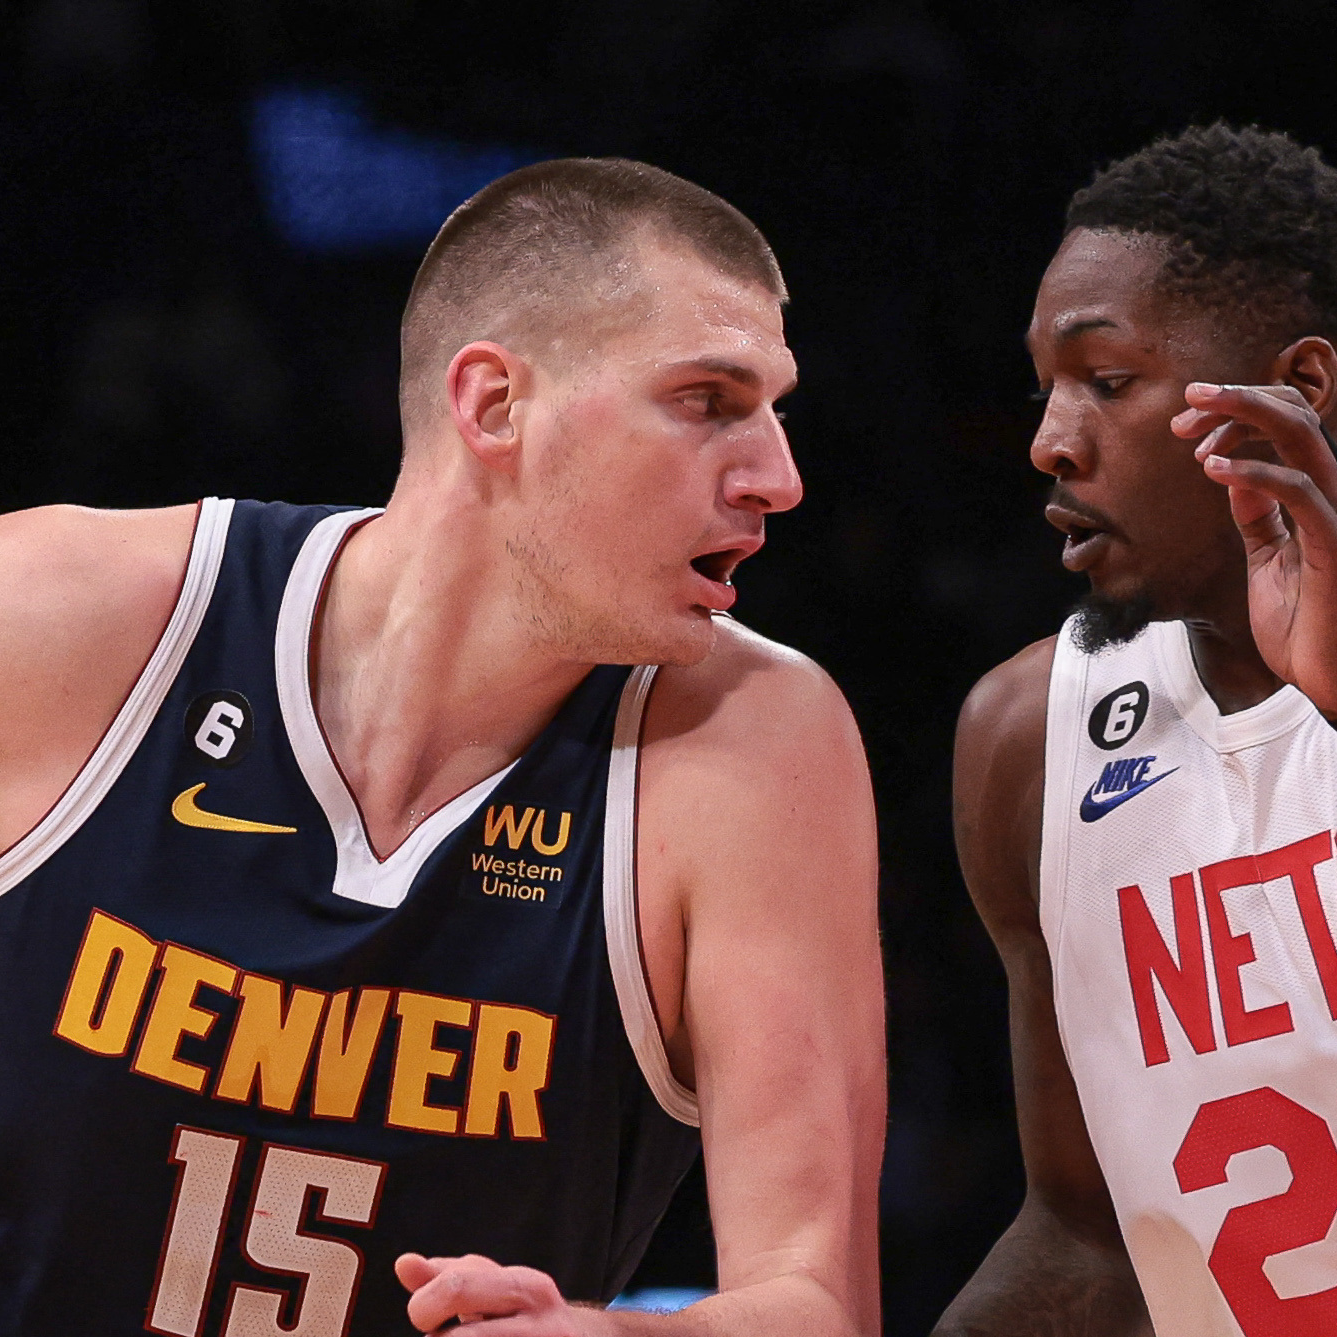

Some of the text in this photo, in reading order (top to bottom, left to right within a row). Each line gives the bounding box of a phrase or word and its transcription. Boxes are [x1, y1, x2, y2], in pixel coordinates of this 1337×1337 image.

[194, 700, 244, 760] 6
[1103, 691, 1140, 743] 6
[1093, 755, 1157, 795] NIKE
[484, 804, 572, 856] WU
[471, 852, 564, 882] Western
[481, 875, 546, 903] Union
[53, 907, 559, 1142] DENVER
